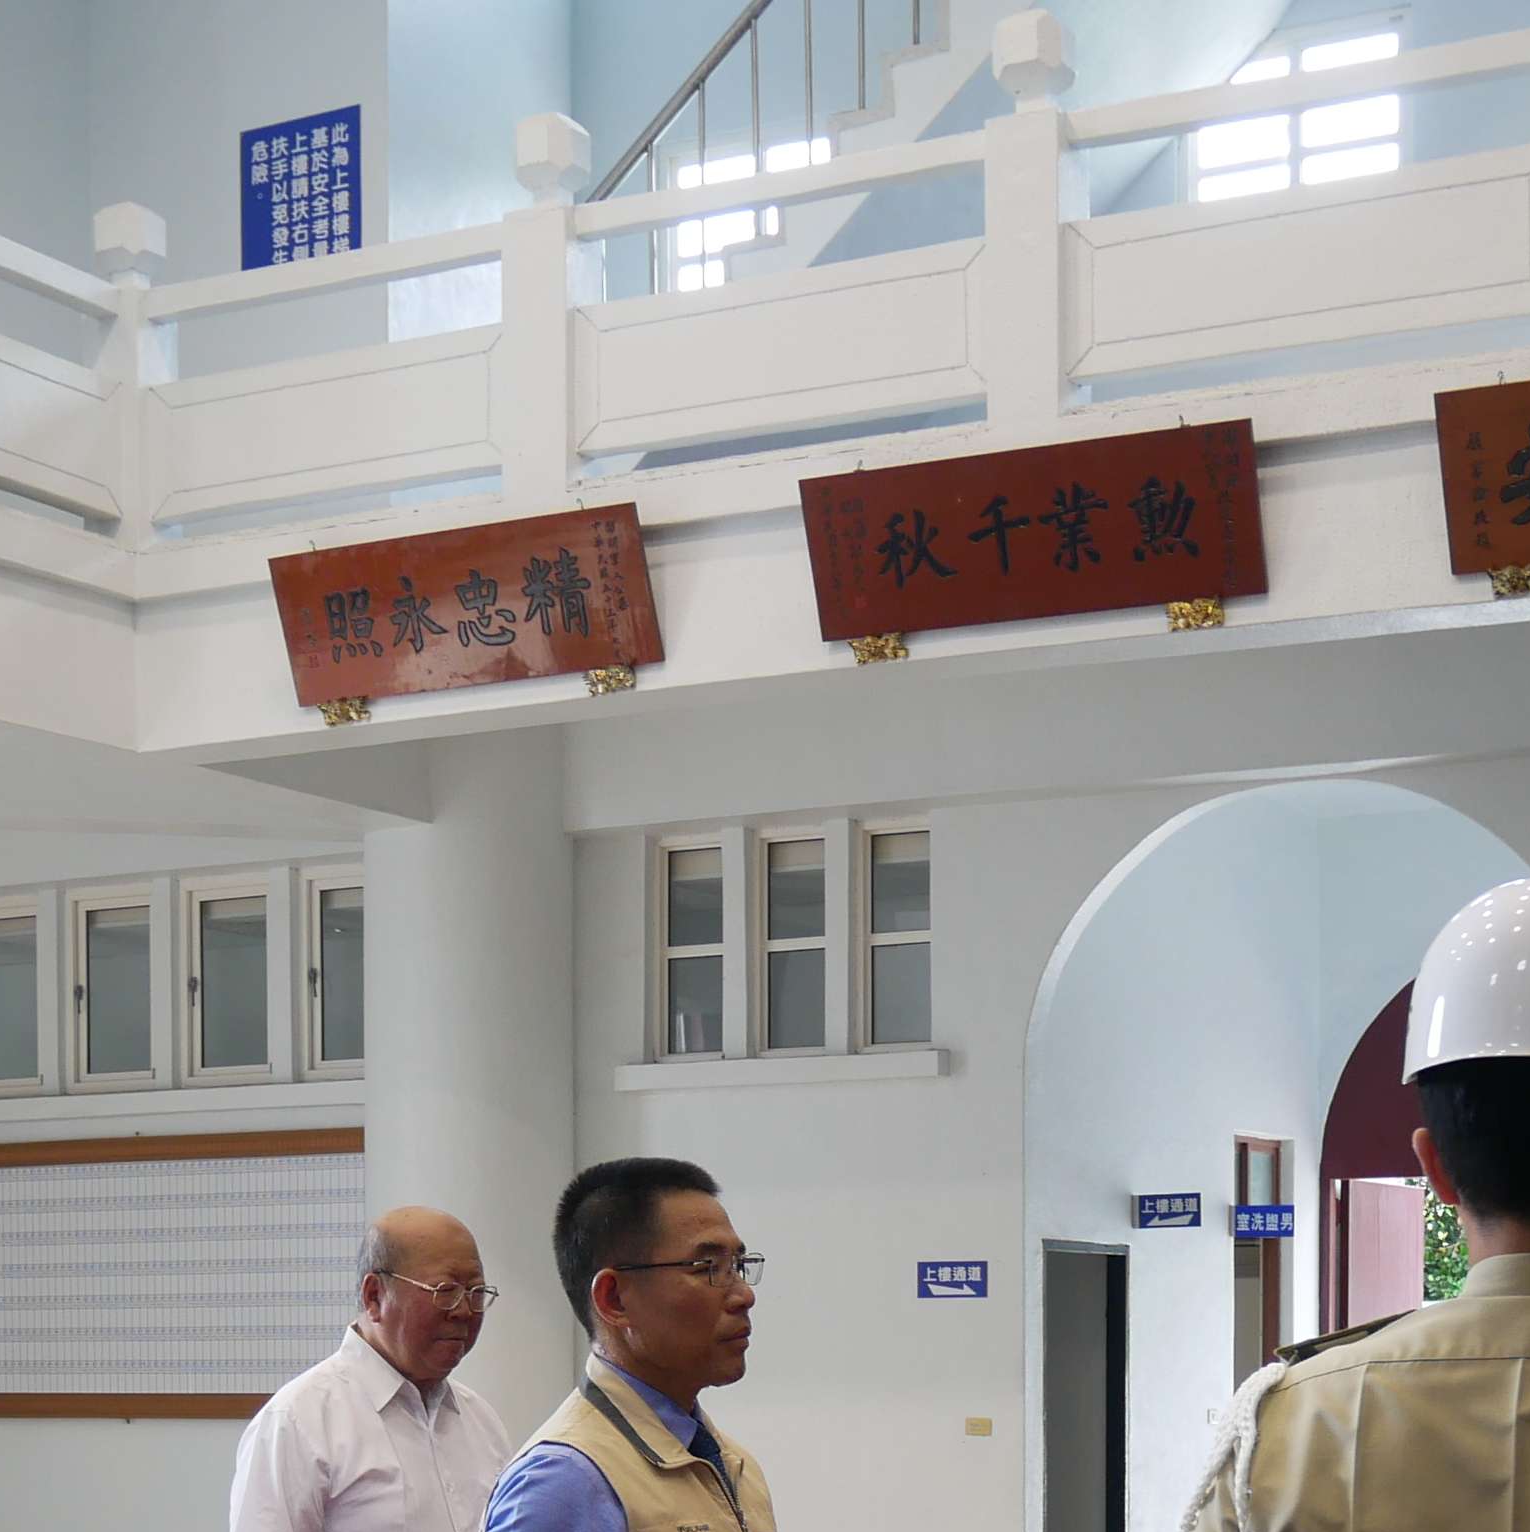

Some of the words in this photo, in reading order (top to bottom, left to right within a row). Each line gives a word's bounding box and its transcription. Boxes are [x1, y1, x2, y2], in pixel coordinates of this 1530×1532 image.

[875, 474, 1201, 590] 勳業千秋
[323, 543, 593, 664] 精忠永照
[1141, 1197, 1198, 1214] 上樓通道
[1236, 1212, 1294, 1232] 男盥洗室
[923, 1266, 982, 1282] 上樓通道
